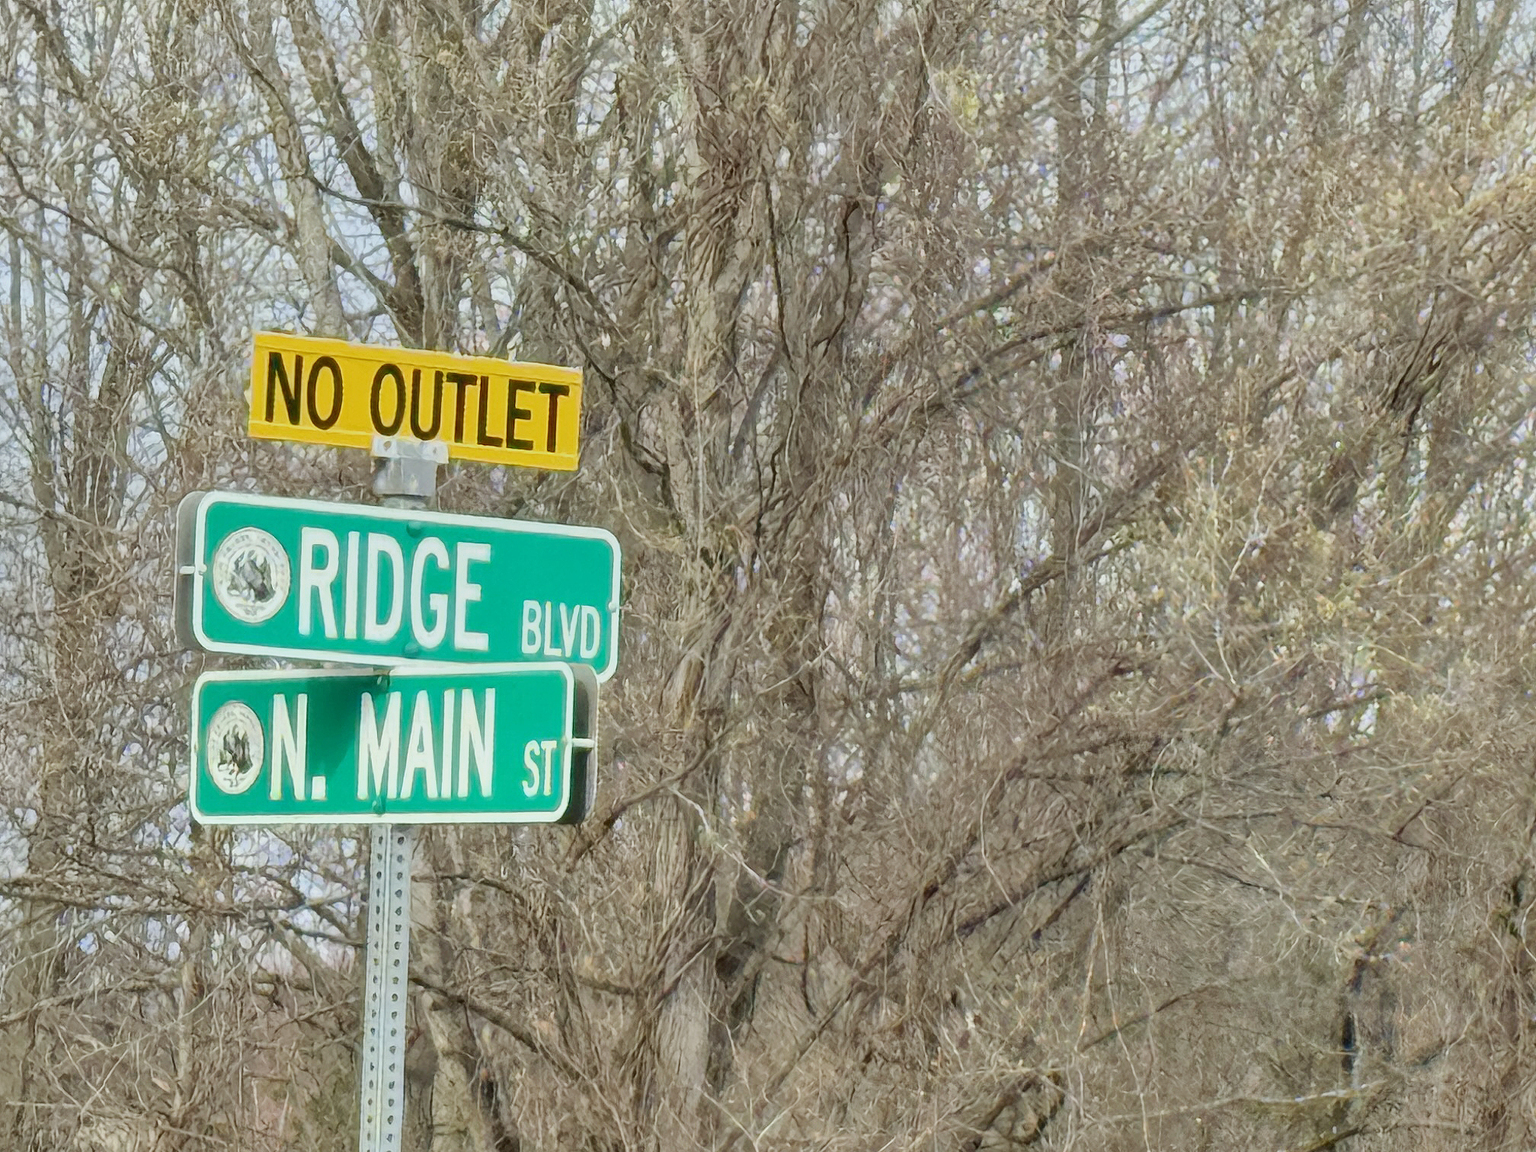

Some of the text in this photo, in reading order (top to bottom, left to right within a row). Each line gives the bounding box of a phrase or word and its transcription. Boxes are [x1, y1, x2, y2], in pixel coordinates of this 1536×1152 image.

[265, 351, 570, 453] NO OUTLET
[298, 527, 492, 652] RIDGE
[521, 600, 601, 660] BLVD
[270, 693, 327, 801] N.
[357, 688, 496, 801] MAIN
[522, 740, 557, 798] ST
